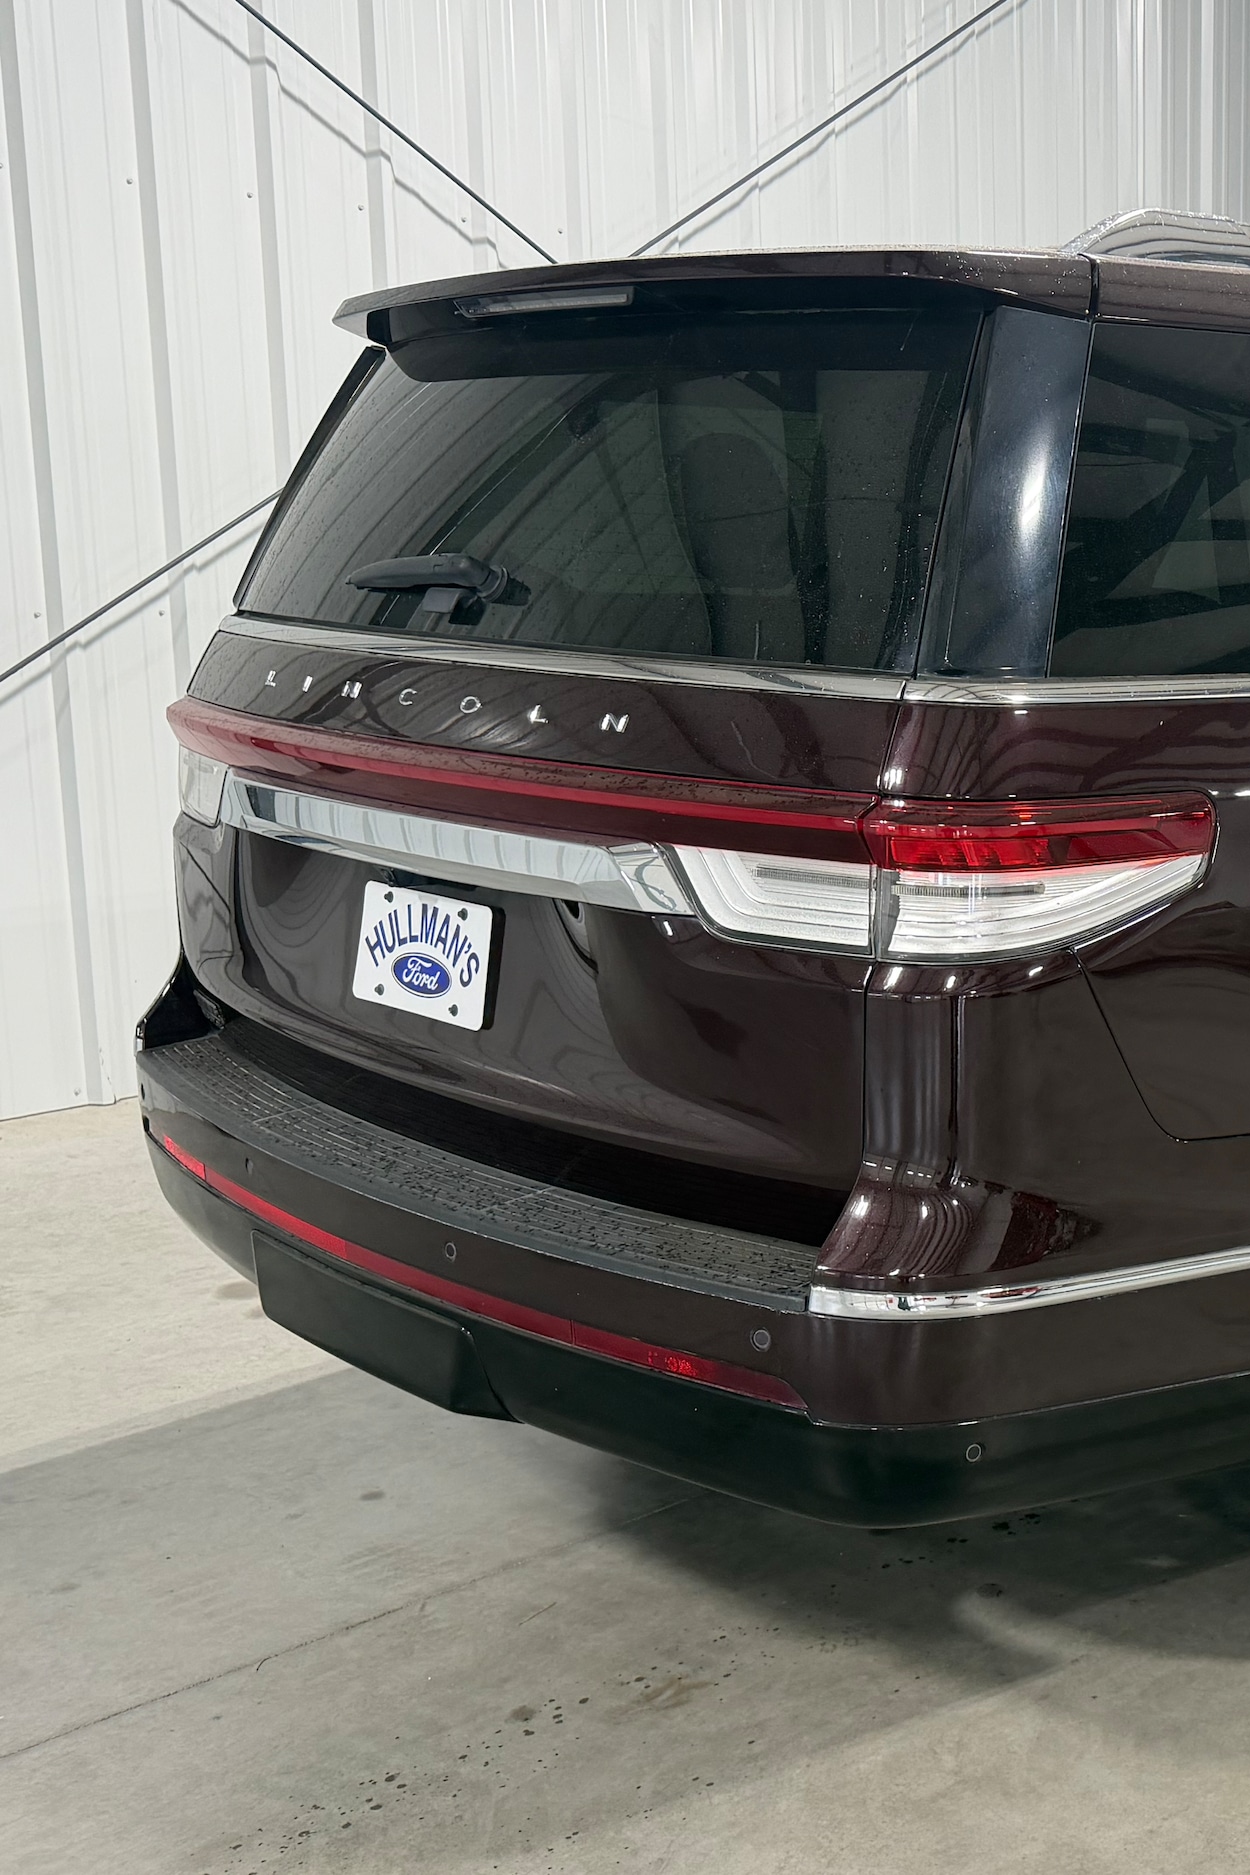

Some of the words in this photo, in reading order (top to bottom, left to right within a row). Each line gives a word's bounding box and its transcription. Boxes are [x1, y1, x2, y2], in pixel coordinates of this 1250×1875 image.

[265, 670, 629, 733] LINCOLN
[364, 903, 480, 988] HULLMAN'S
[402, 957, 441, 991] Ford
